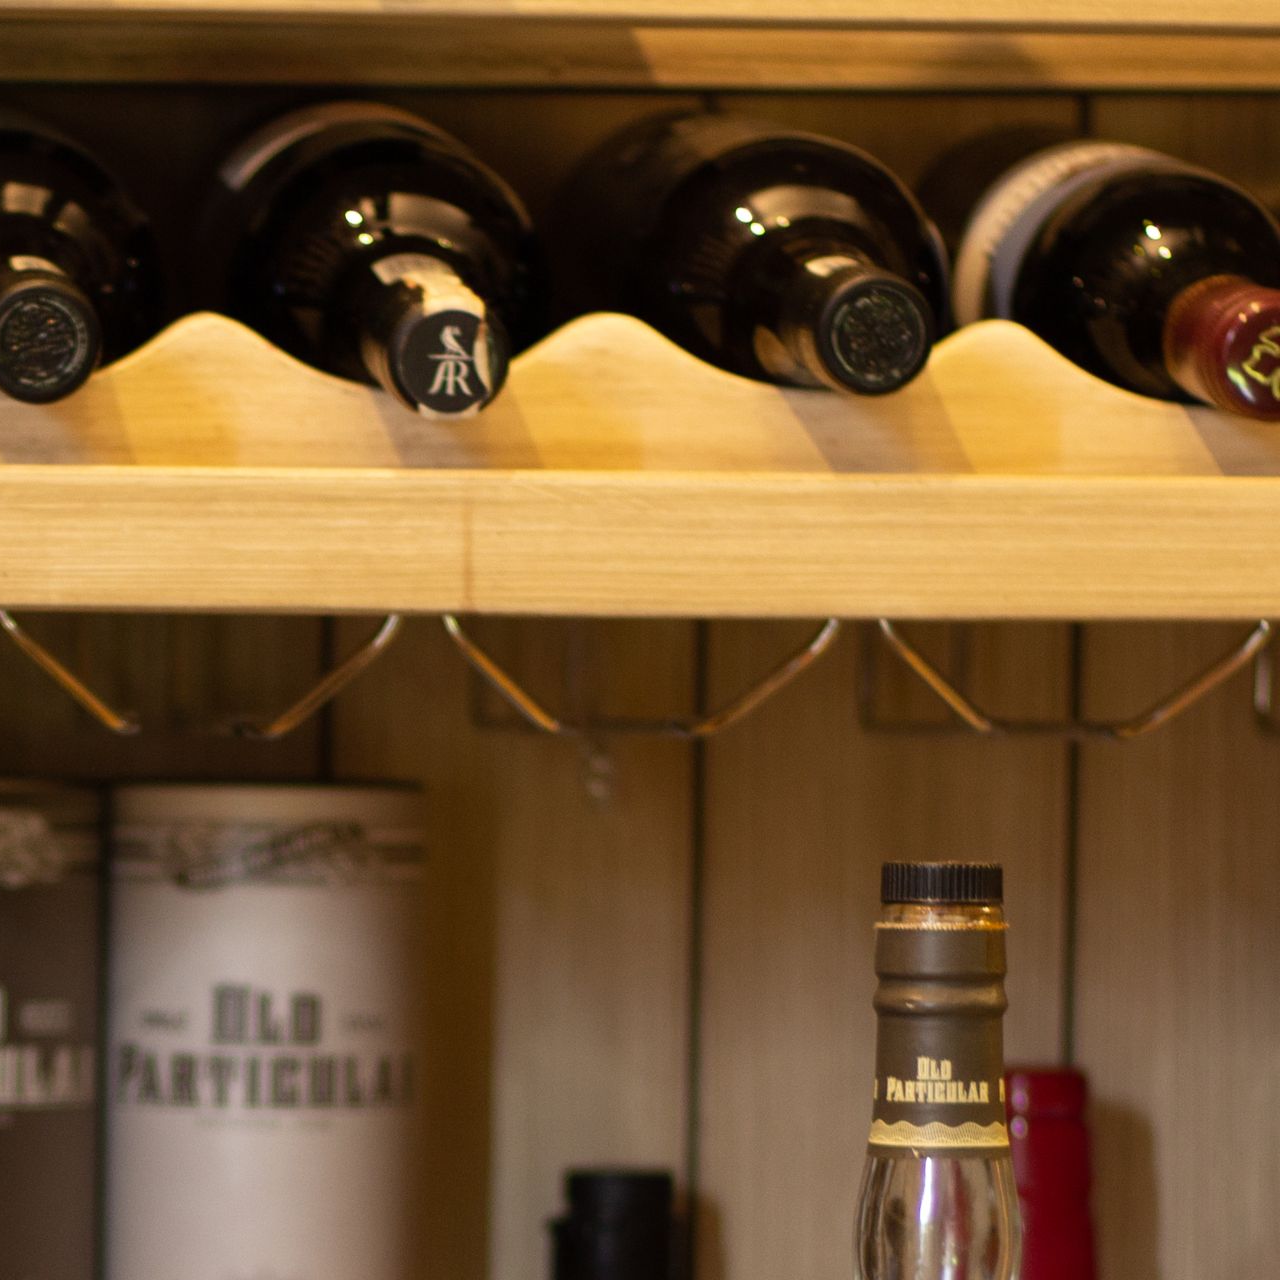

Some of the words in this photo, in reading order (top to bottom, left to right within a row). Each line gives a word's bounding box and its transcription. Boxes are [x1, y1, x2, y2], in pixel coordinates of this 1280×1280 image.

[212, 983, 322, 1045] OLD
[916, 1055, 953, 1081] OLD
[885, 1076, 990, 1104] PARTICULAR
